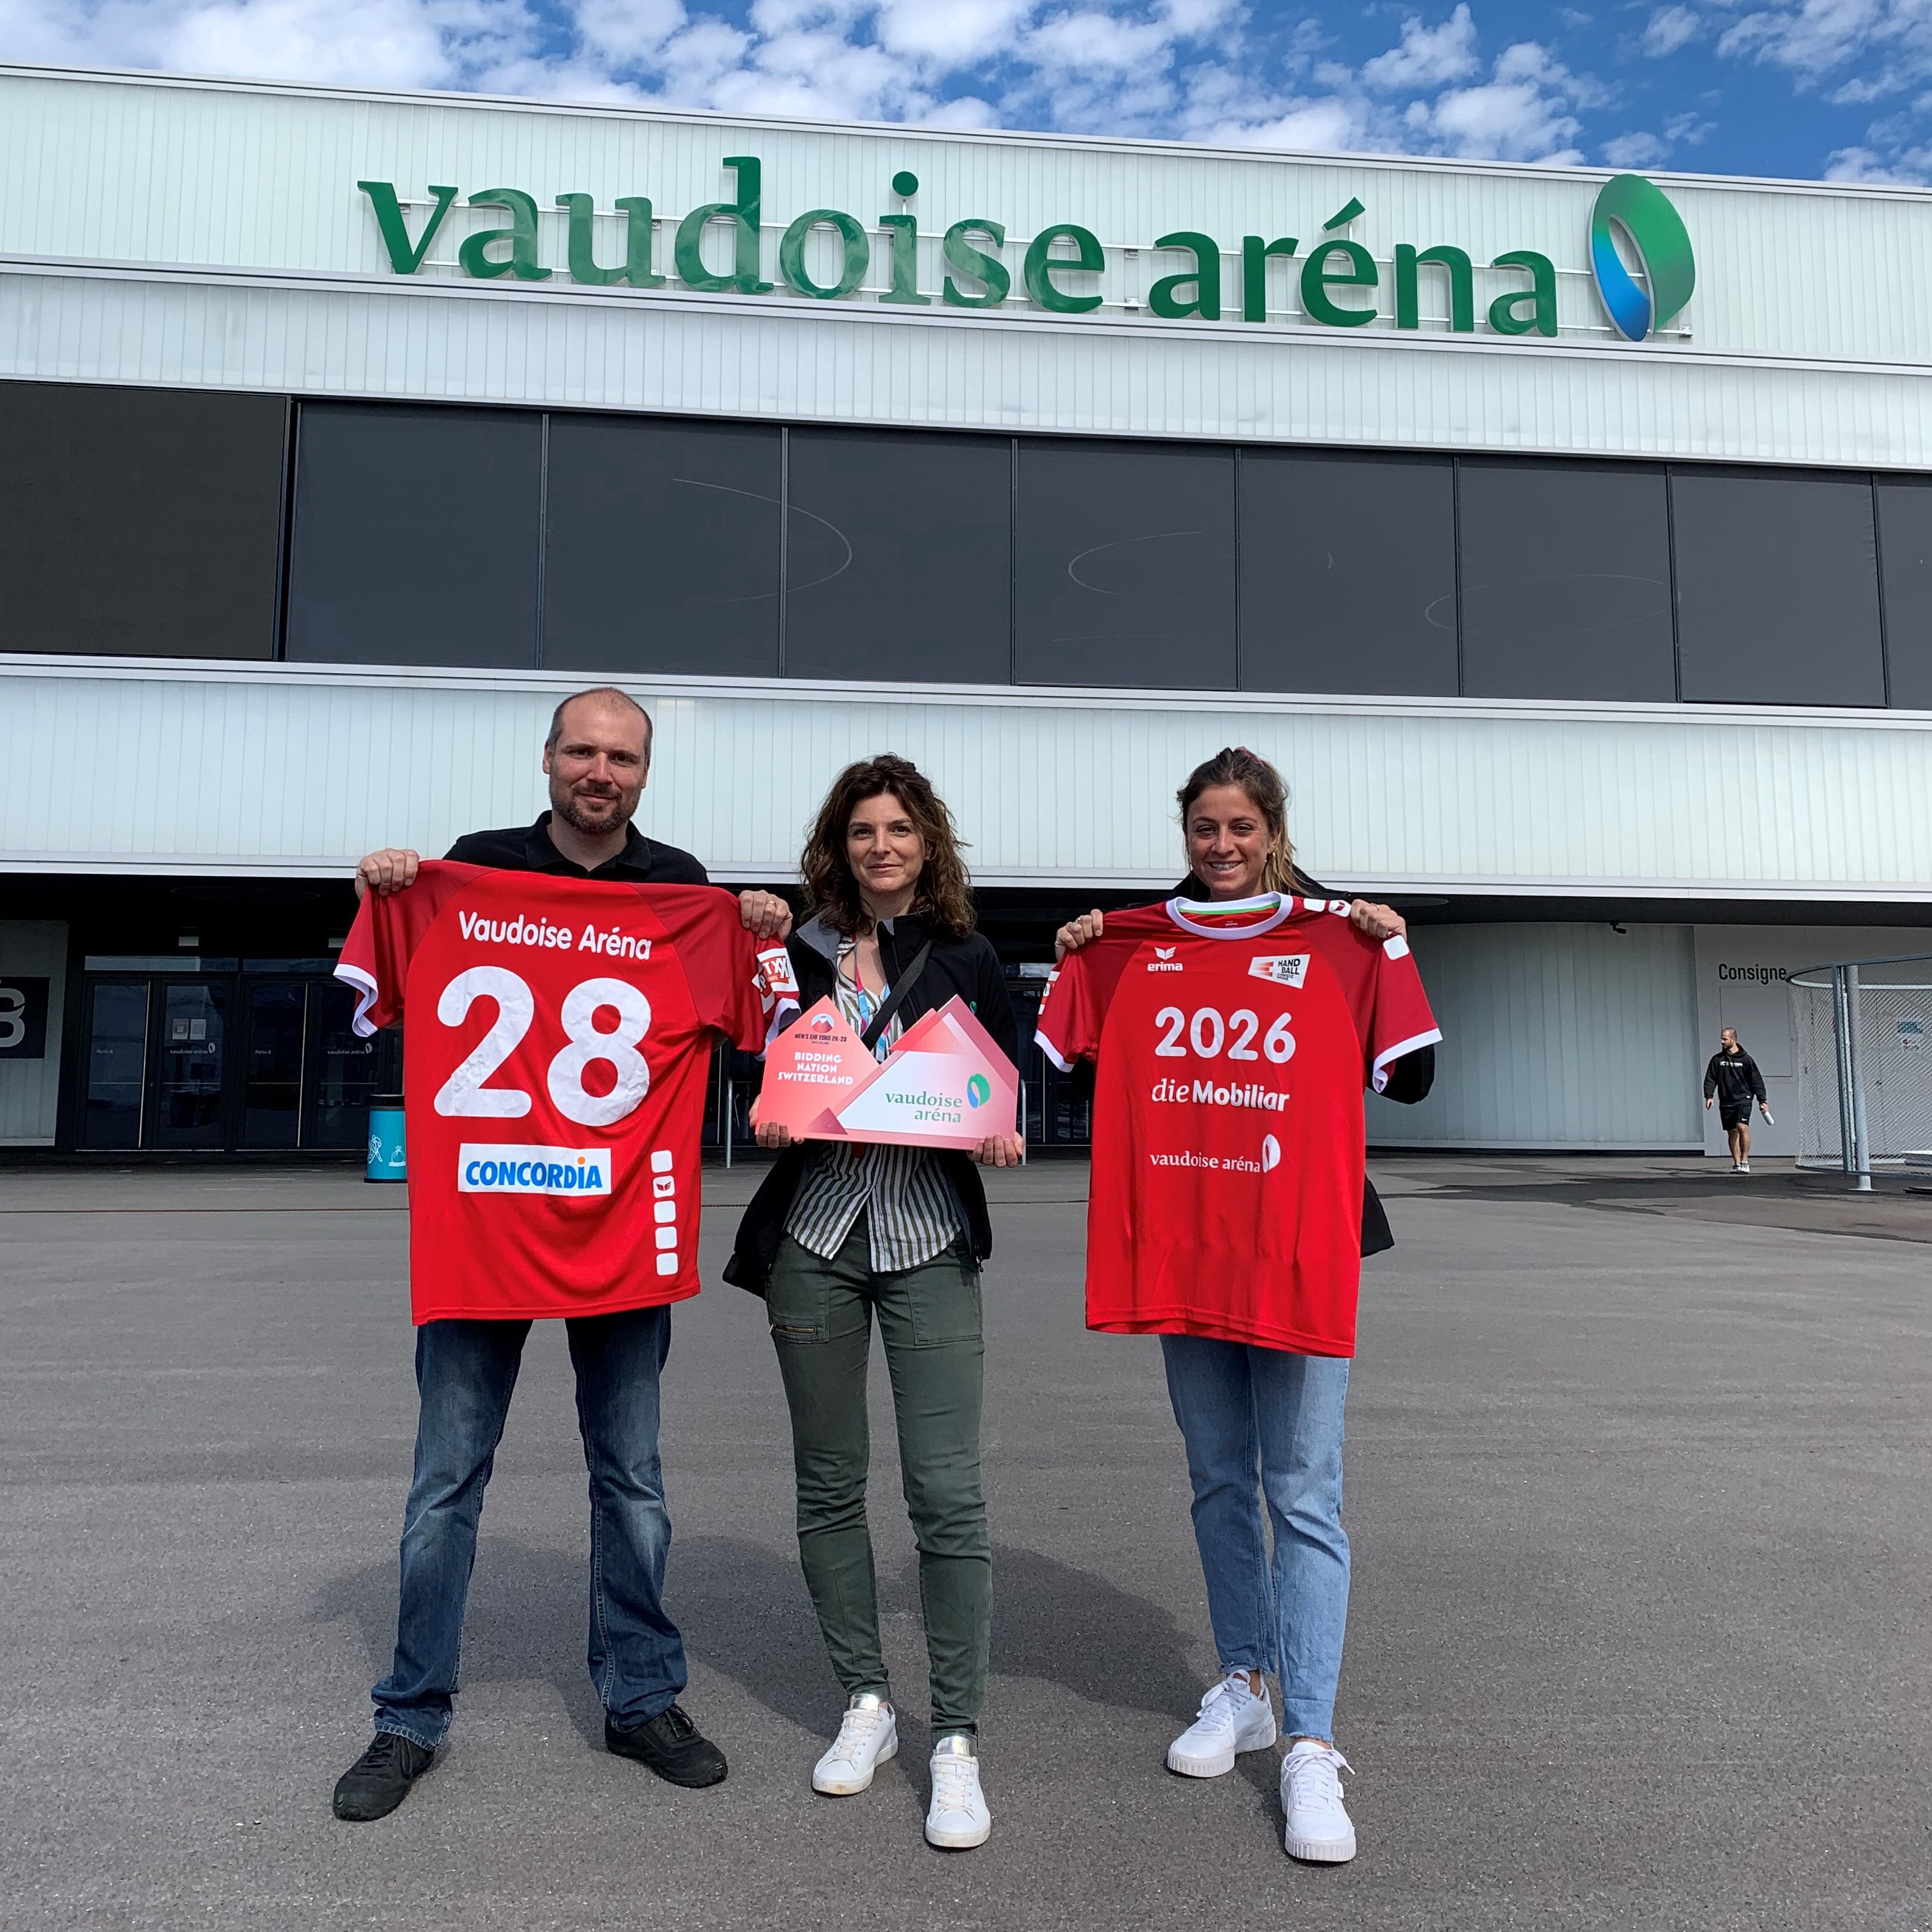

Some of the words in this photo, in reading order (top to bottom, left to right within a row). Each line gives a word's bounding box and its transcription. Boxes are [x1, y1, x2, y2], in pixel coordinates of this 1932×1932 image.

[357, 157, 1106, 314] vaudoise
[1149, 196, 1559, 337] aréna
[458, 910, 573, 949] Vaudoise
[578, 924, 652, 960] Aréna
[1147, 962, 1183, 972] erima
[1278, 958, 1301, 967] HAND
[1282, 967, 1300, 975] BALL
[1718, 963, 1787, 985] Consigne
[1154, 1006, 1296, 1064] 2026
[434, 965, 652, 1128] 28
[794, 1052, 843, 1063] BIDDING
[797, 1062, 838, 1073] NATION
[778, 1071, 854, 1085] SWITZERLAND
[885, 1091, 963, 1108] vaudoise
[914, 1108, 962, 1123] aréna
[1149, 1150, 1219, 1169] vaudoise
[1222, 1155, 1261, 1173] aréna
